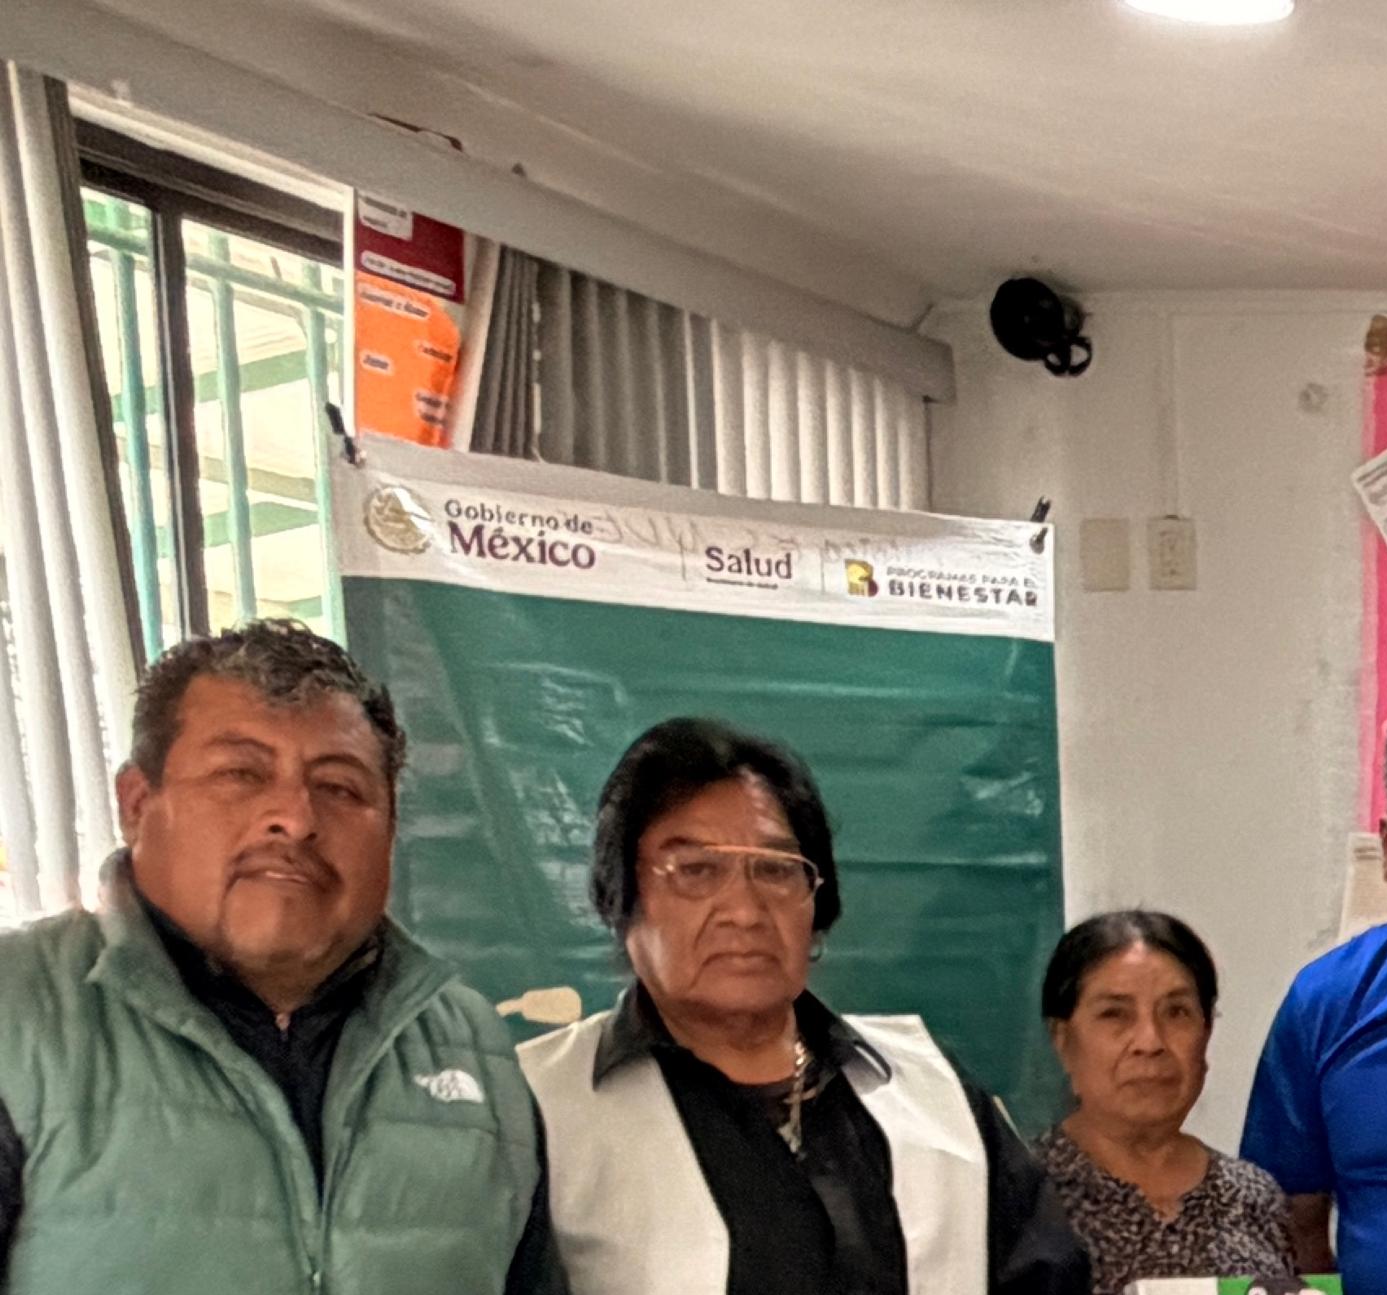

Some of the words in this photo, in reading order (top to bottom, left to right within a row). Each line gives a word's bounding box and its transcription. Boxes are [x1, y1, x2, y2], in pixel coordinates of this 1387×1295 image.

[444, 498, 558, 530] Gobierno
[565, 513, 593, 536] de
[448, 519, 598, 569] México
[704, 545, 793, 580] Salud
[888, 579, 1038, 607] BIENESTAR
